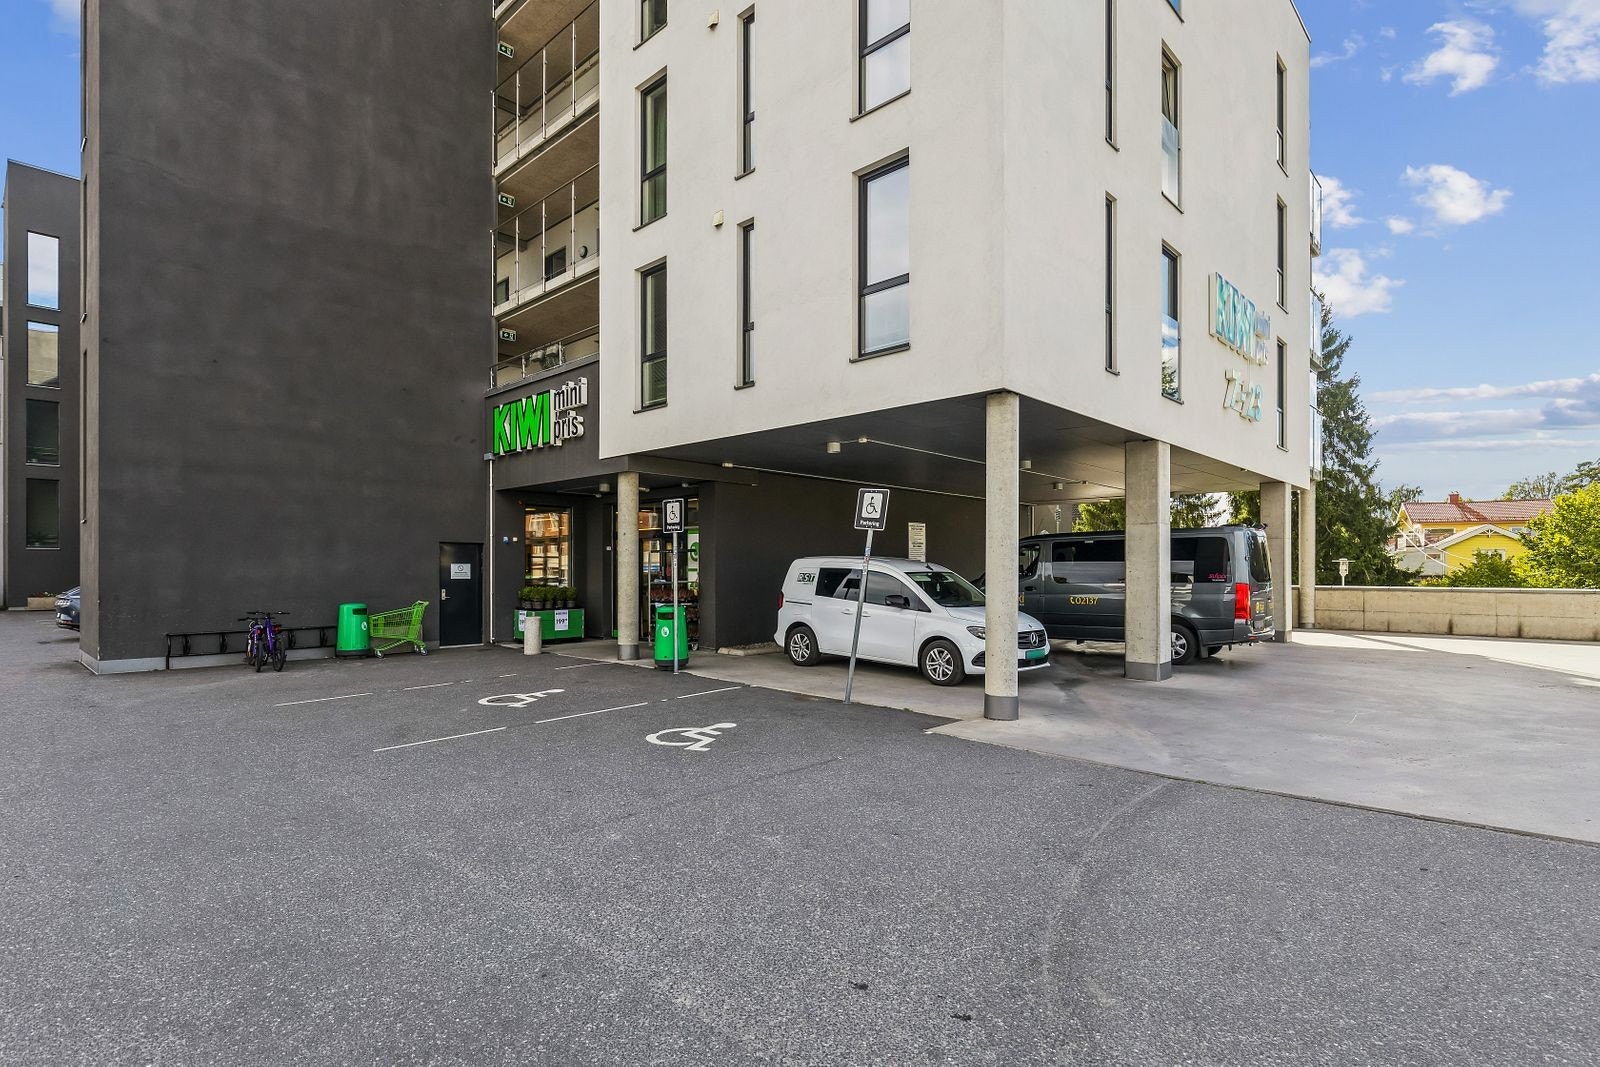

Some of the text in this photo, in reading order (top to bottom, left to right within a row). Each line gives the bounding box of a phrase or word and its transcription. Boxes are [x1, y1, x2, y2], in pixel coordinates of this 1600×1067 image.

[554, 377, 587, 411] mini
[493, 390, 553, 456] KIWI
[554, 412, 583, 446] pris
